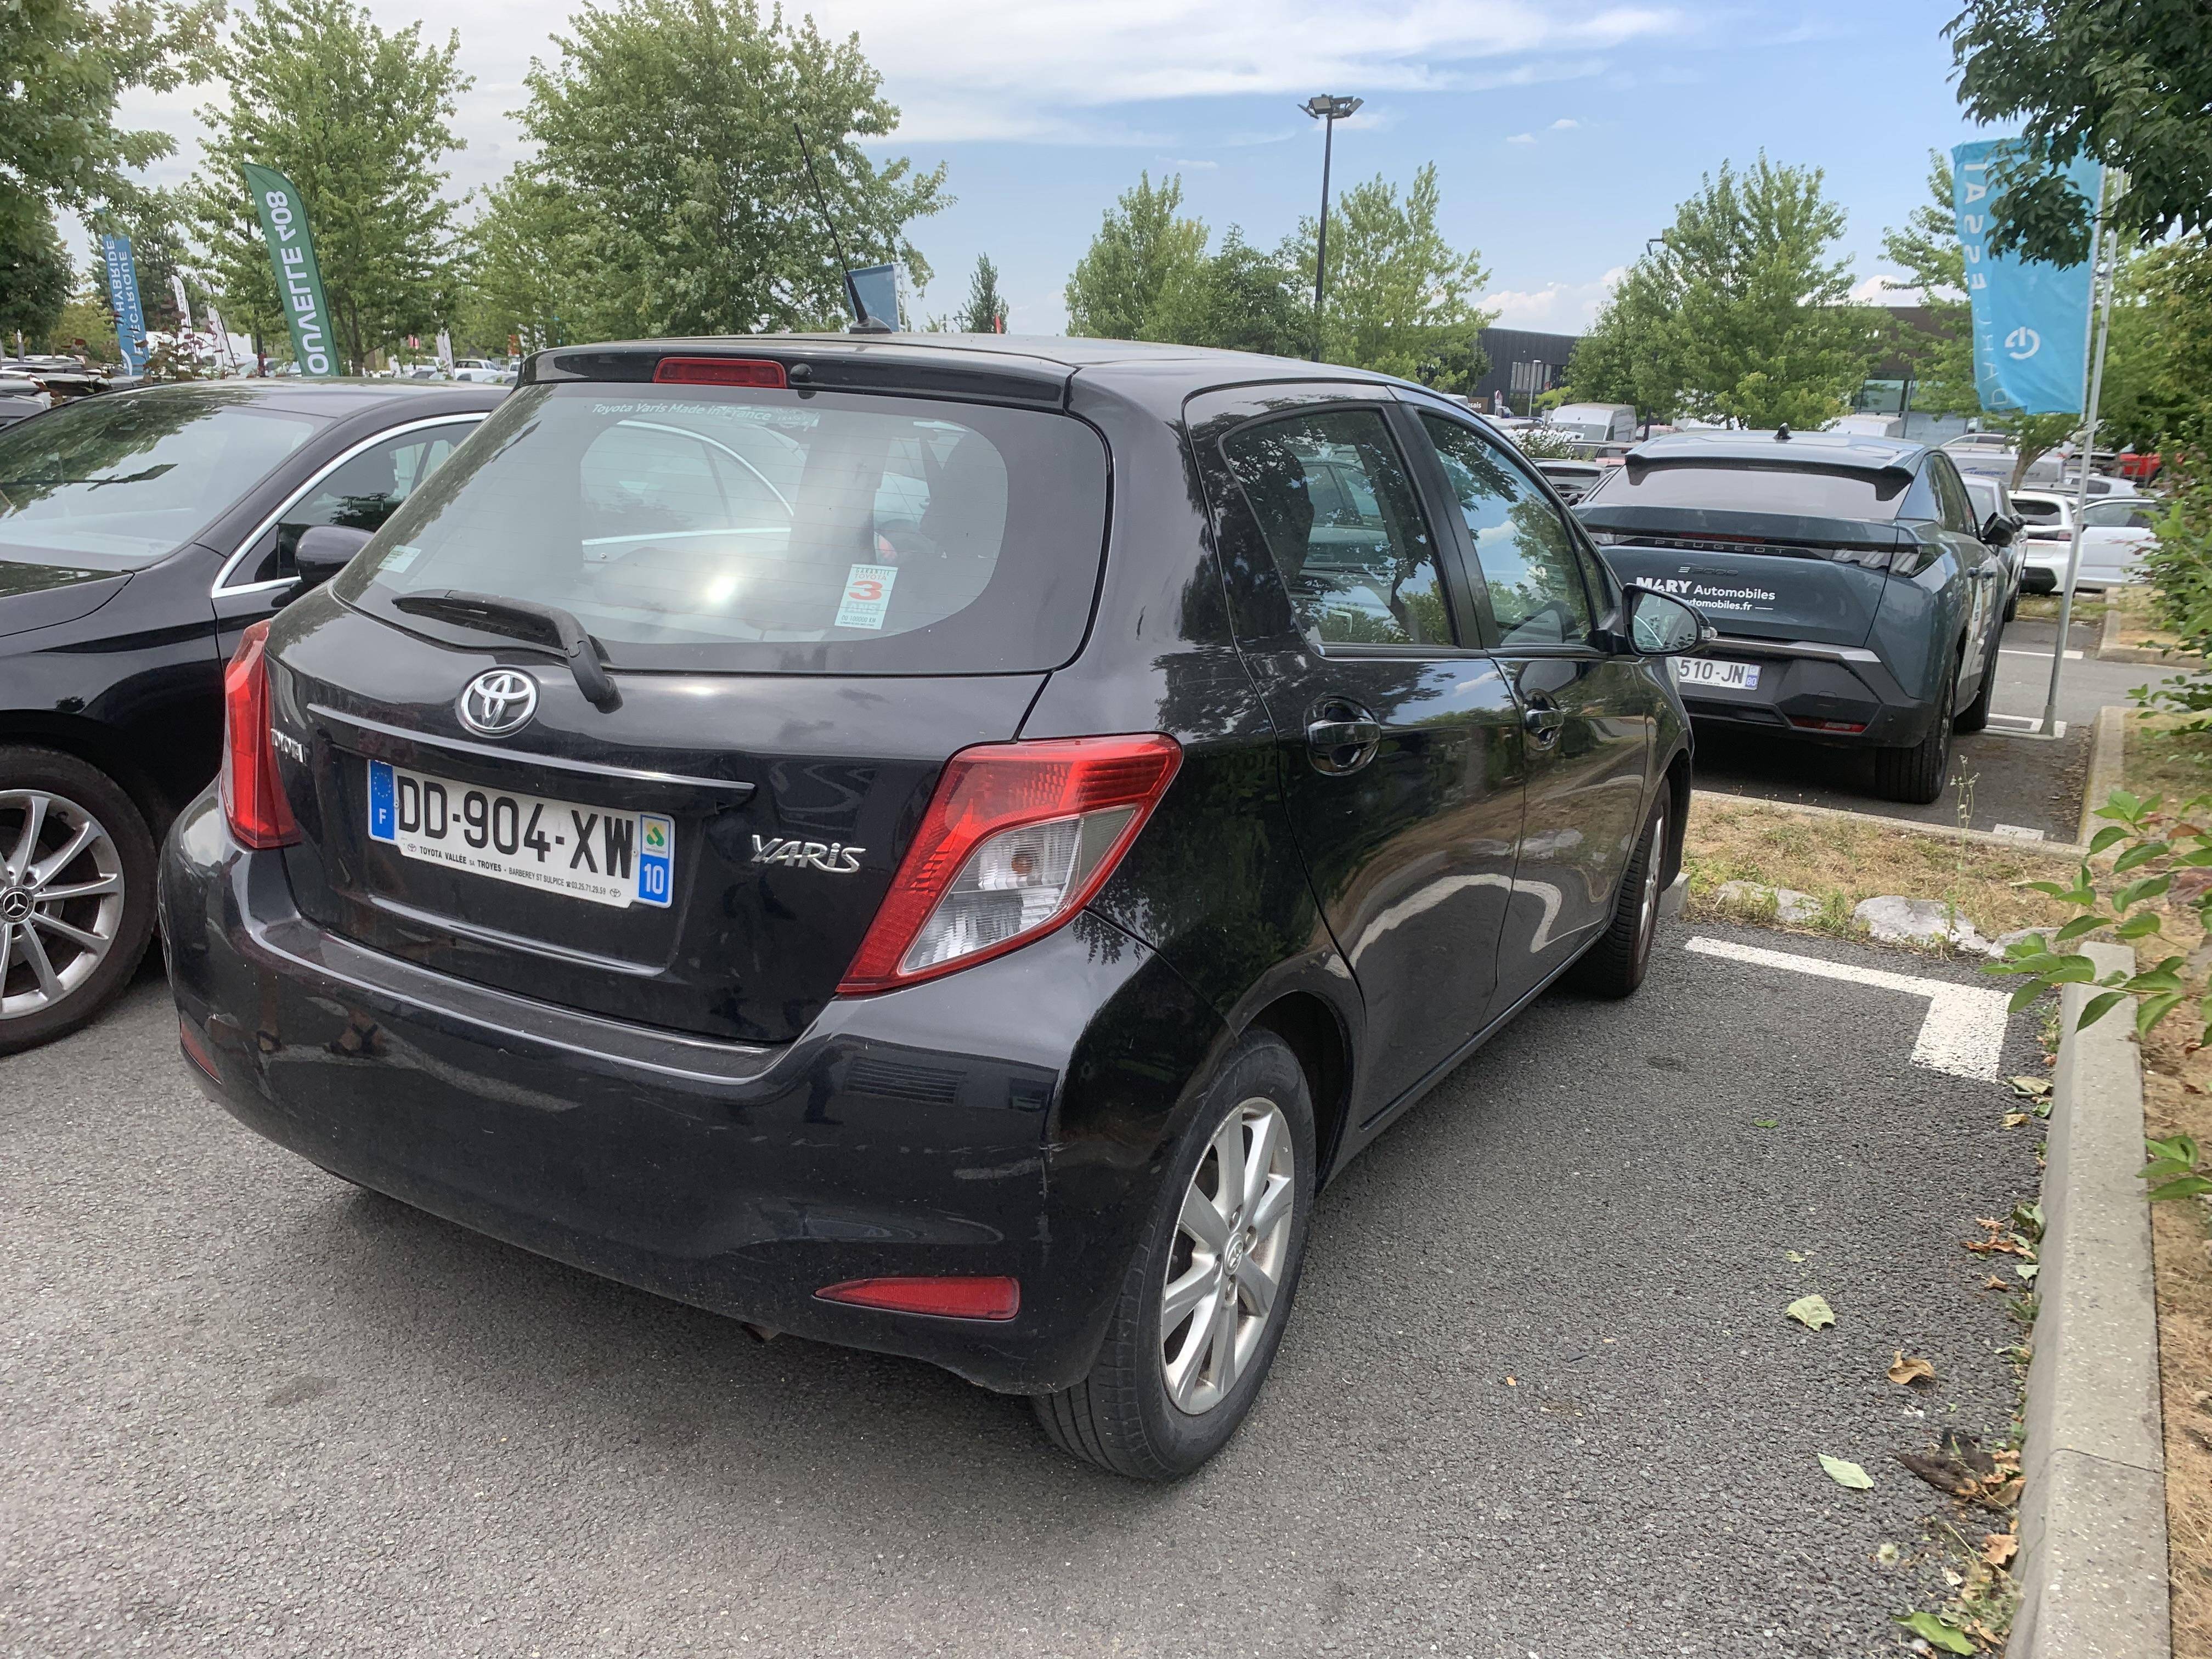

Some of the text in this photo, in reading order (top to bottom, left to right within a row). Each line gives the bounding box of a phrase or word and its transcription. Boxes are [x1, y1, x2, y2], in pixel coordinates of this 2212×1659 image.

[592, 403, 633, 413] Toyota
[635, 403, 667, 413] Yaris
[668, 404, 706, 414] Made
[707, 405, 720, 415] in
[720, 405, 772, 420] France
[1655, 539, 1786, 554] PEUGEOT
[848, 580, 883, 600] 3
[1636, 577, 1775, 600] MARY Automobiles
[1686, 598, 1752, 611] utomobiles.fr
[1680, 659, 1745, 684] 510-JN
[1747, 676, 1757, 686] 80
[379, 808, 386, 825] F
[397, 775, 634, 879] DD-904-XW
[420, 846, 442, 859] TOYOTA
[445, 852, 466, 864] VALLÉE
[477, 860, 501, 872] TROYES
[509, 867, 535, 879] BARBEREY
[544, 876, 564, 886] SULPICE
[644, 863, 664, 895] 10
